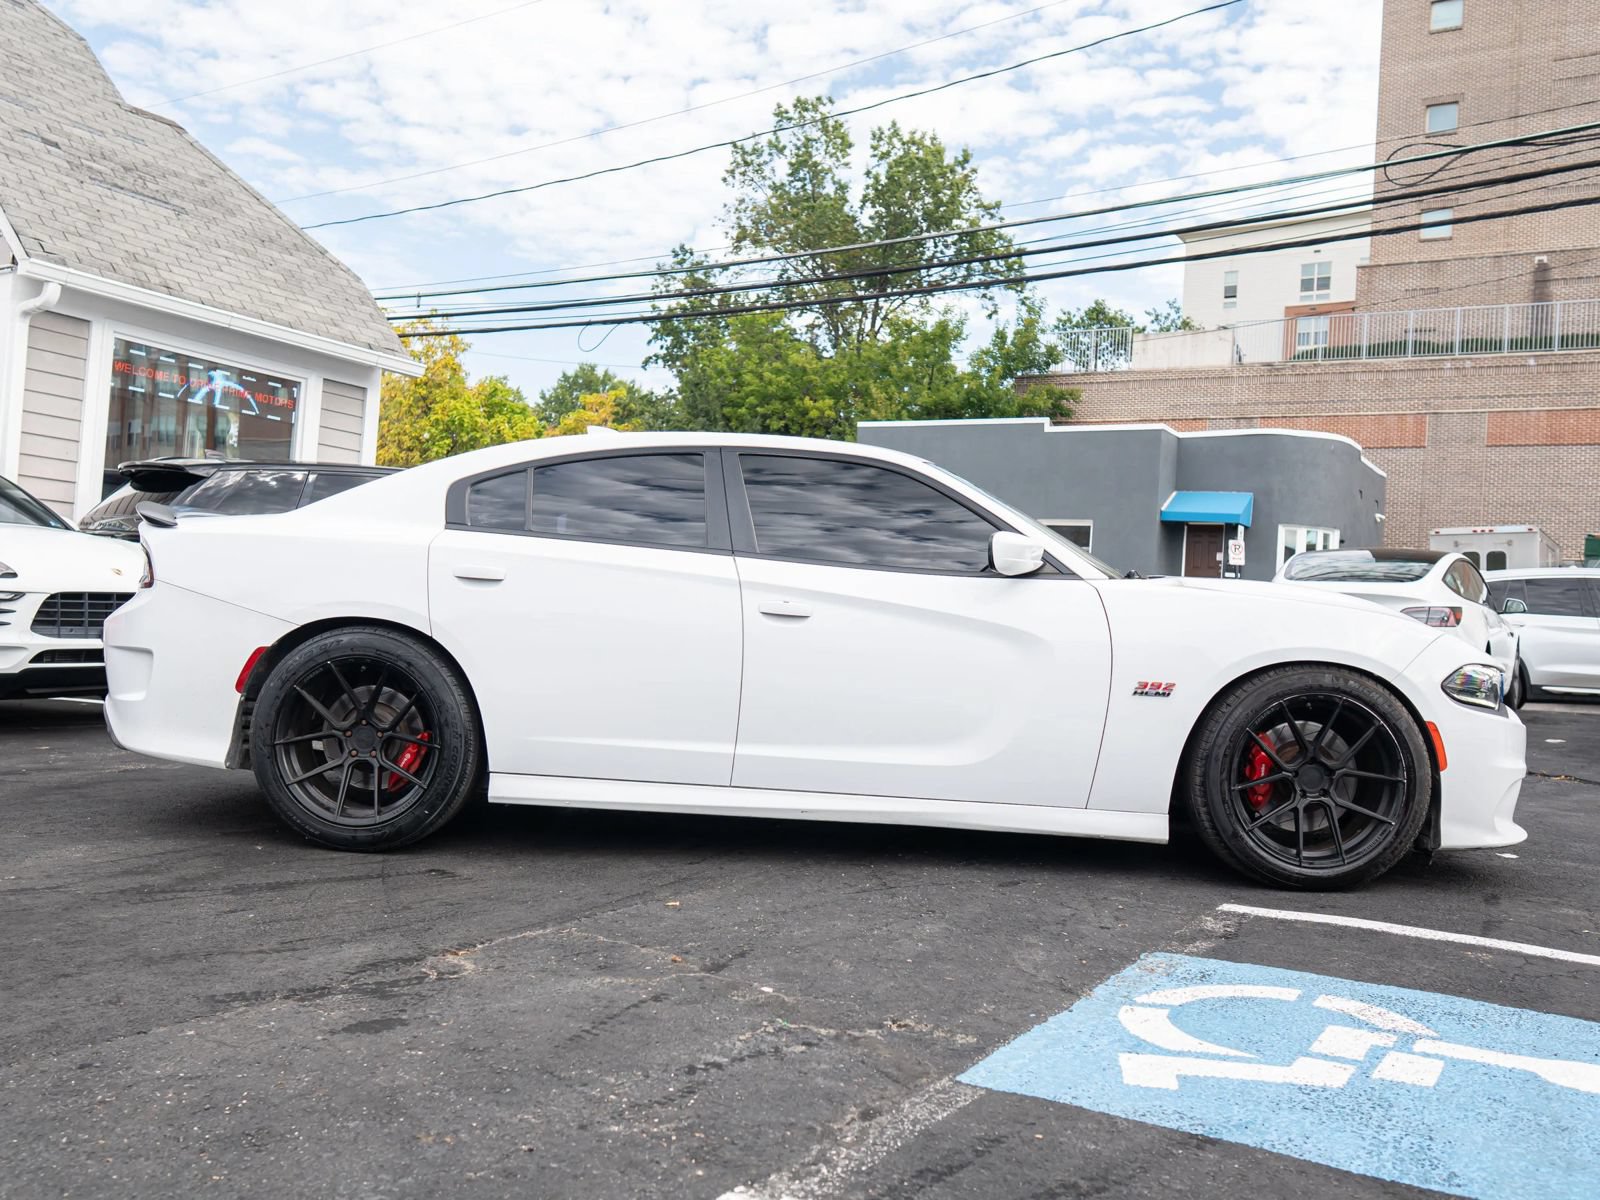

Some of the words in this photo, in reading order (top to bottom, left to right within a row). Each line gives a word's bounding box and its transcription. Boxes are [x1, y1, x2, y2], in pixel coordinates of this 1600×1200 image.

[114, 361, 169, 381] WELCOME
[173, 374, 186, 385] TO
[254, 392, 293, 409] MOTORS
[1134, 681, 1176, 691] 392
